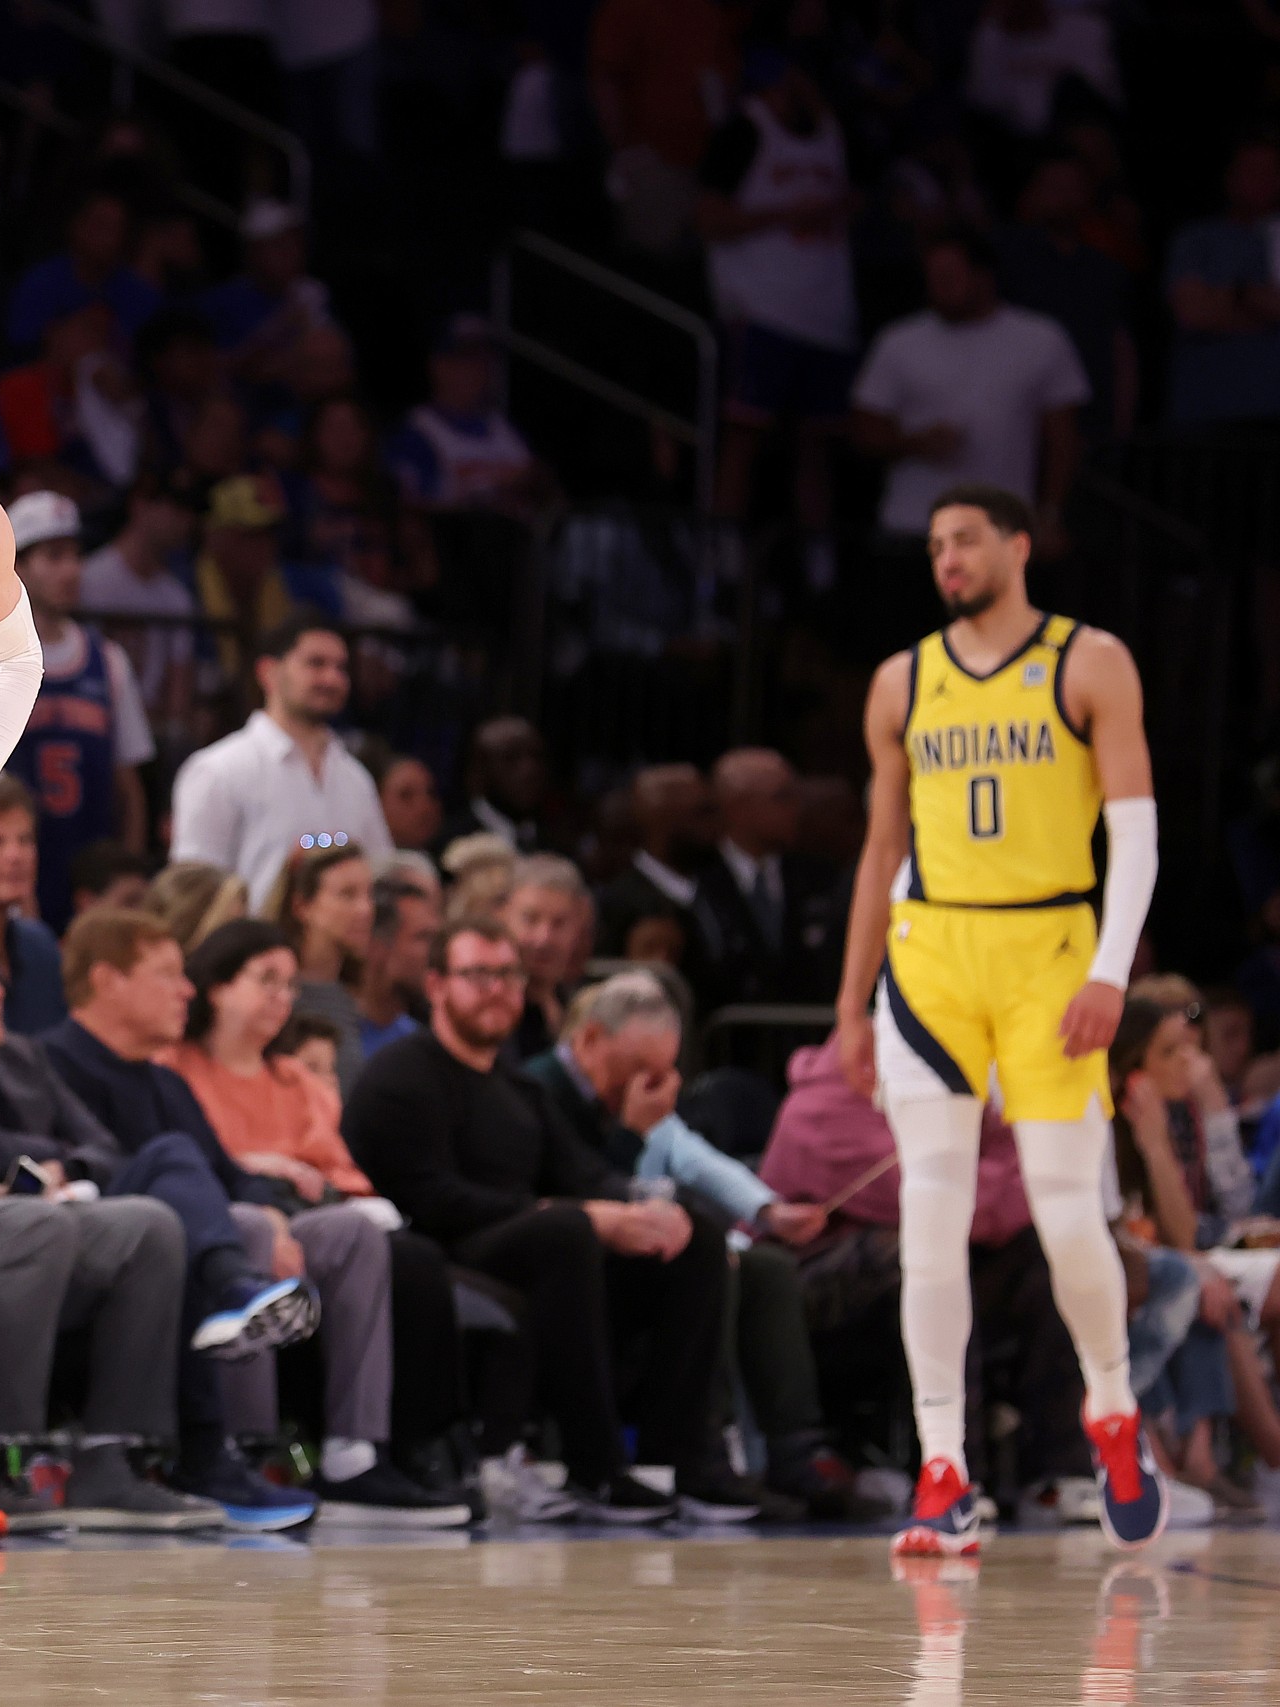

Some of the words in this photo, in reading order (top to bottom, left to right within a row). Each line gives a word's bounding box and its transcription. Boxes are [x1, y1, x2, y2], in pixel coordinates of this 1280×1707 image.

[38, 741, 82, 815] 5
[911, 720, 1057, 776] INDIANA
[969, 775, 1004, 841] 0
